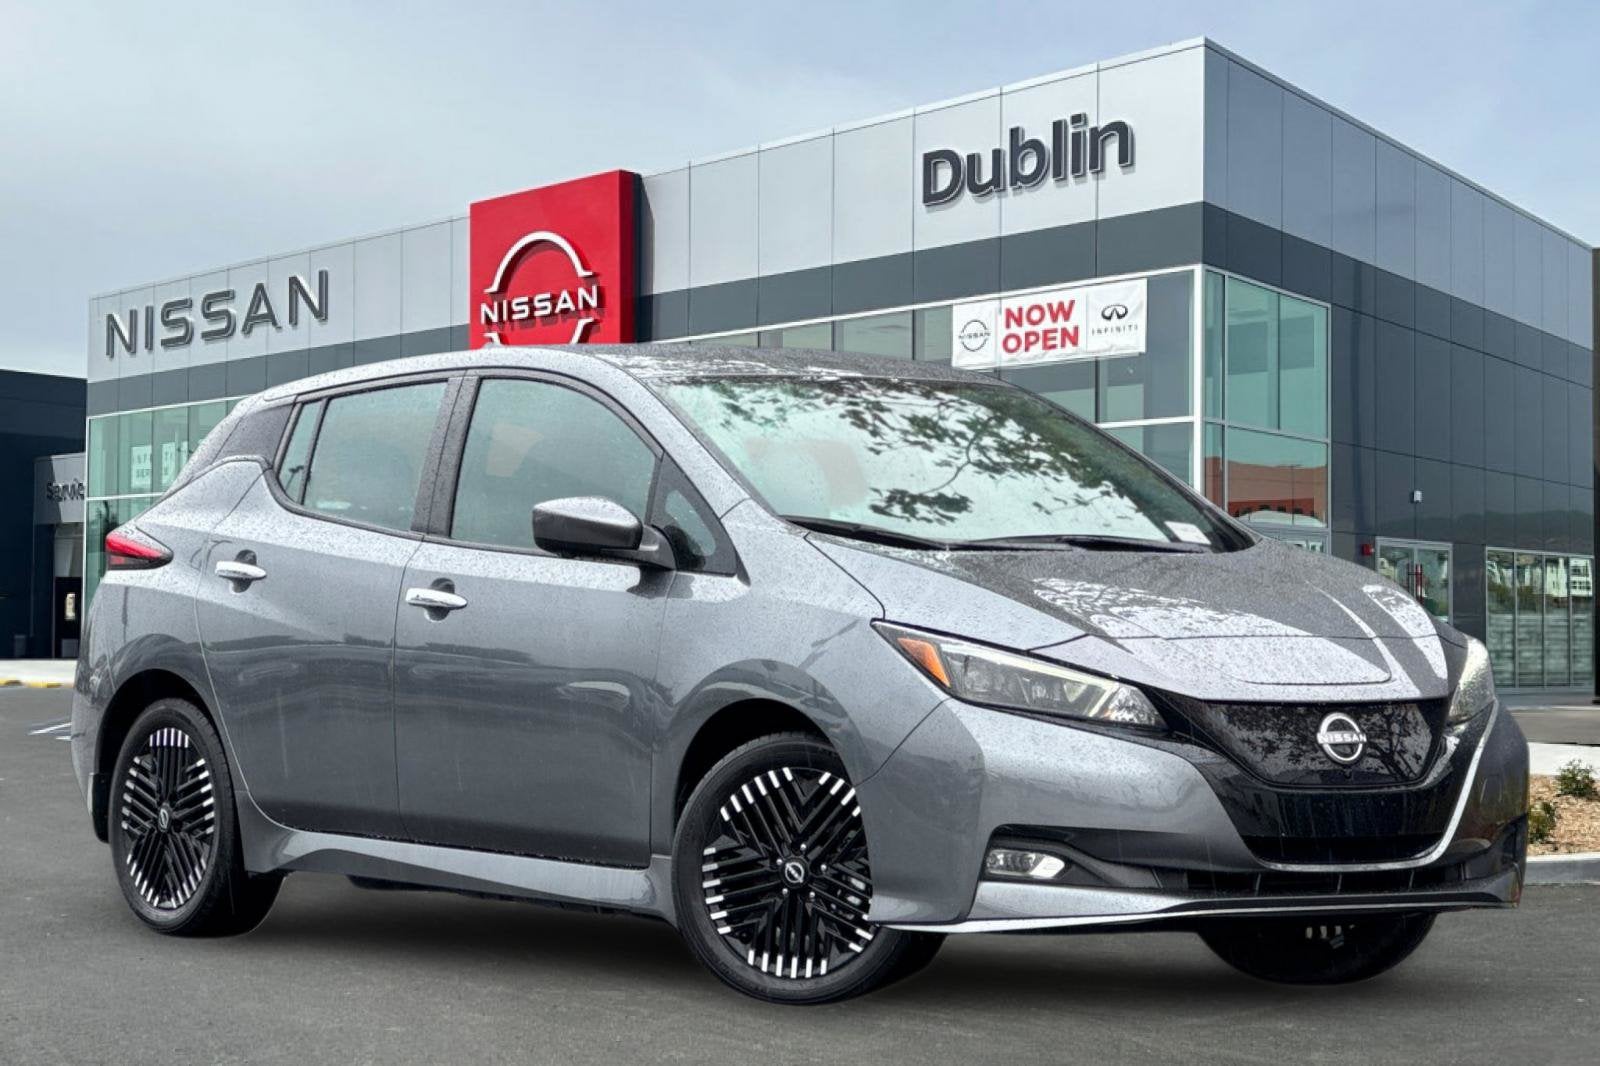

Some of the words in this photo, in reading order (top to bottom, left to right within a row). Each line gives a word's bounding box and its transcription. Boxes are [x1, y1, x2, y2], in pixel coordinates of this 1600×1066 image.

[922, 112, 1134, 206] Dublin
[105, 270, 329, 358] NISSAN
[480, 285, 598, 325] NISSAN
[1004, 299, 1076, 329] NOW
[1002, 326, 1079, 353] OPEN
[46, 478, 85, 502] Servic
[1317, 732, 1367, 744] NISSAN
